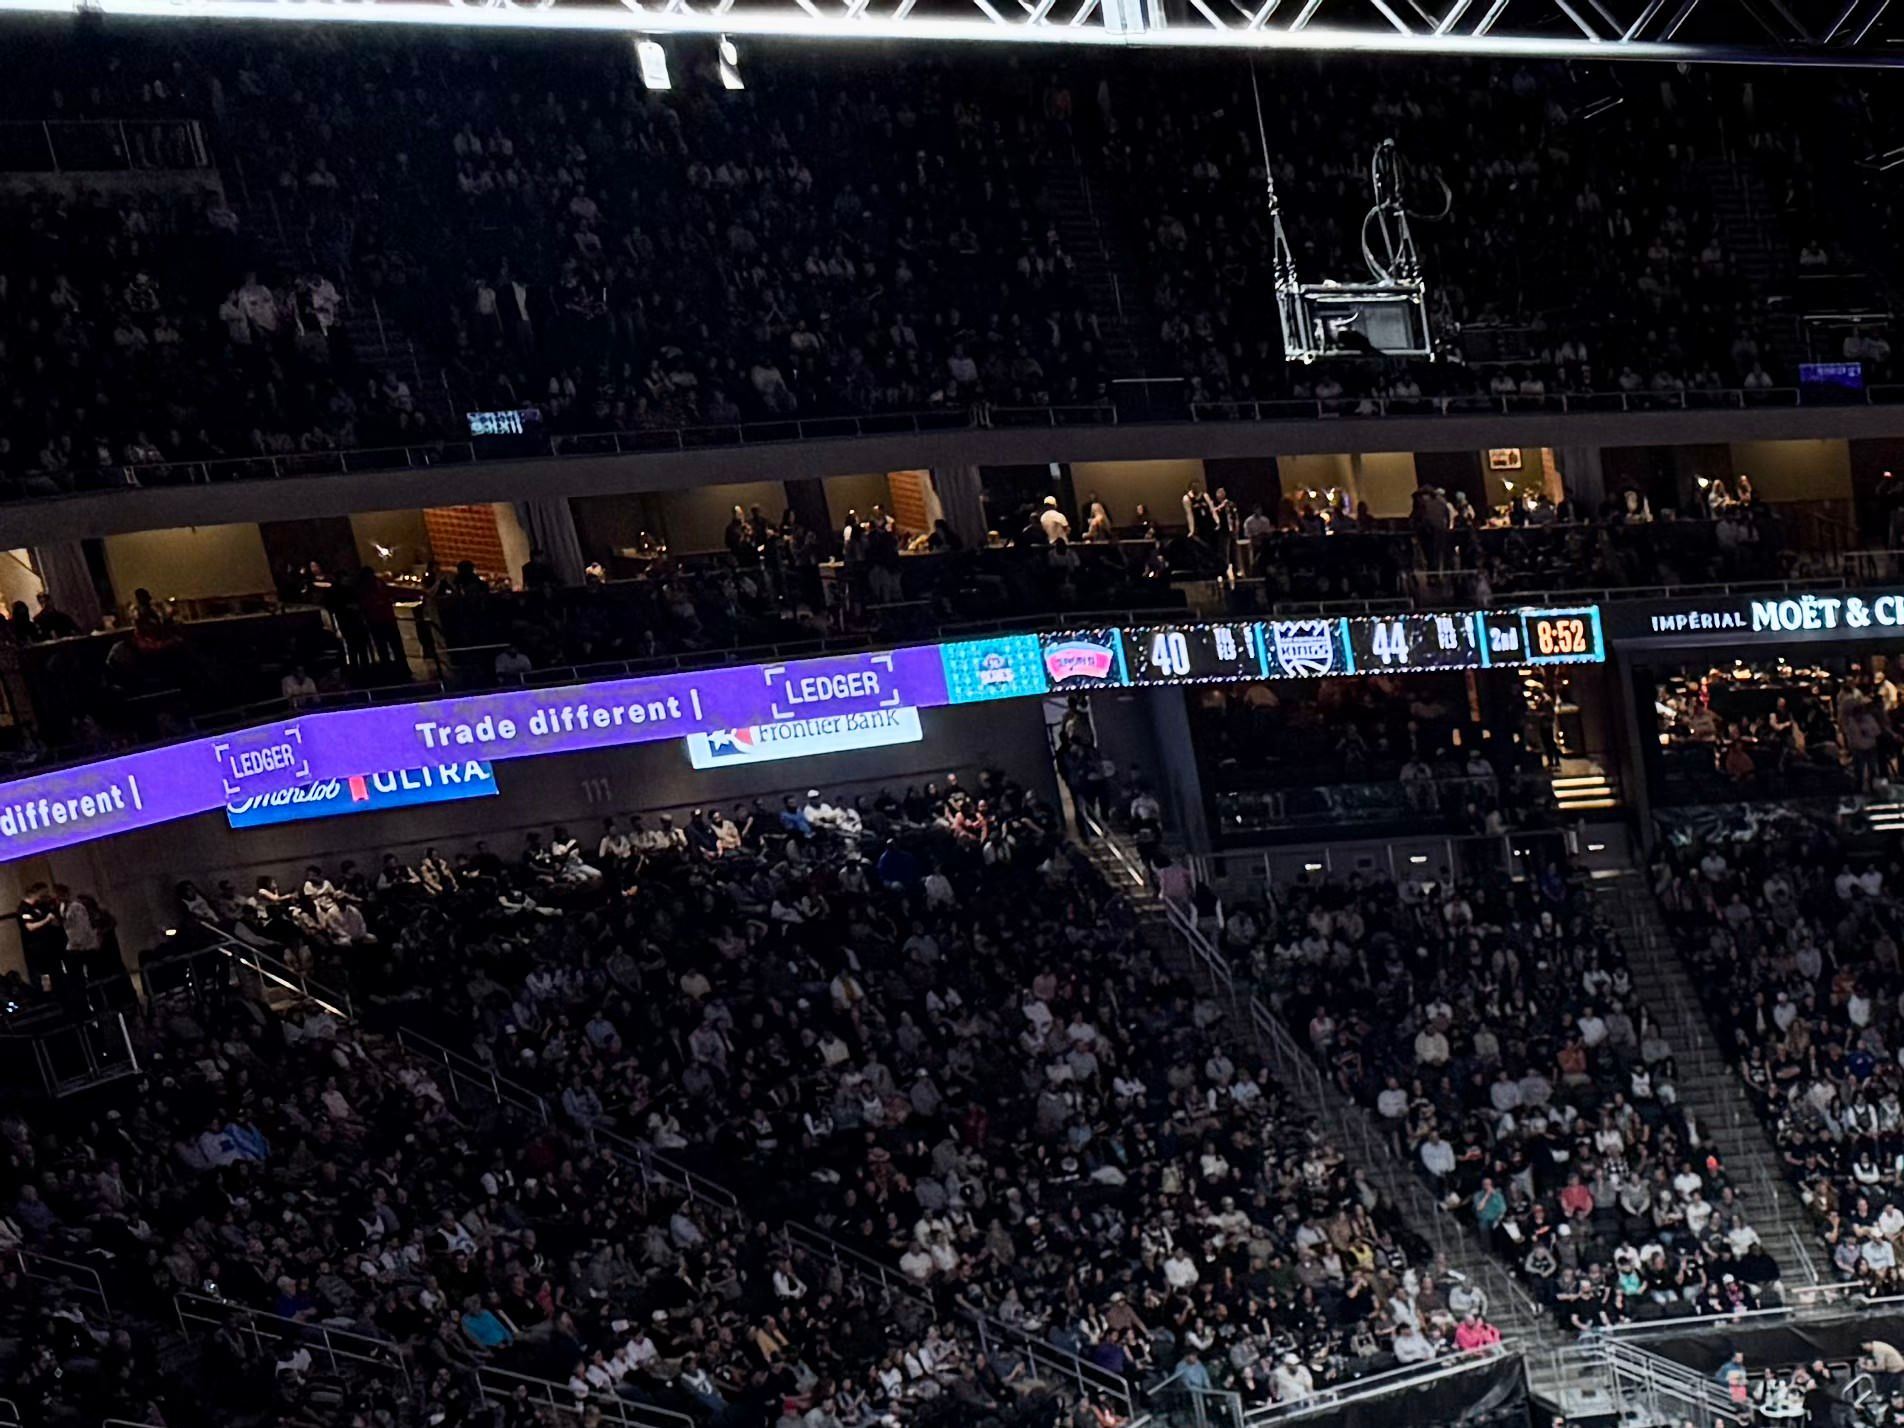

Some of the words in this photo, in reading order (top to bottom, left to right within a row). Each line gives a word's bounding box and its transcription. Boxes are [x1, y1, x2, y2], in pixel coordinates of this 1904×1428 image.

[1651, 608, 1747, 634] IMPÉRIAL
[1751, 594, 1840, 632] MOËT
[1846, 595, 1872, 628] &
[1151, 631, 1191, 676] 40
[1372, 622, 1409, 665] 44
[1490, 627, 1519, 652] 2nd
[1537, 619, 1587, 655] 8:52
[785, 671, 881, 705] LEDGER
[414, 715, 517, 750] Trade
[528, 696, 684, 739] different
[230, 743, 296, 779] LEDGER
[0, 784, 126, 838] different
